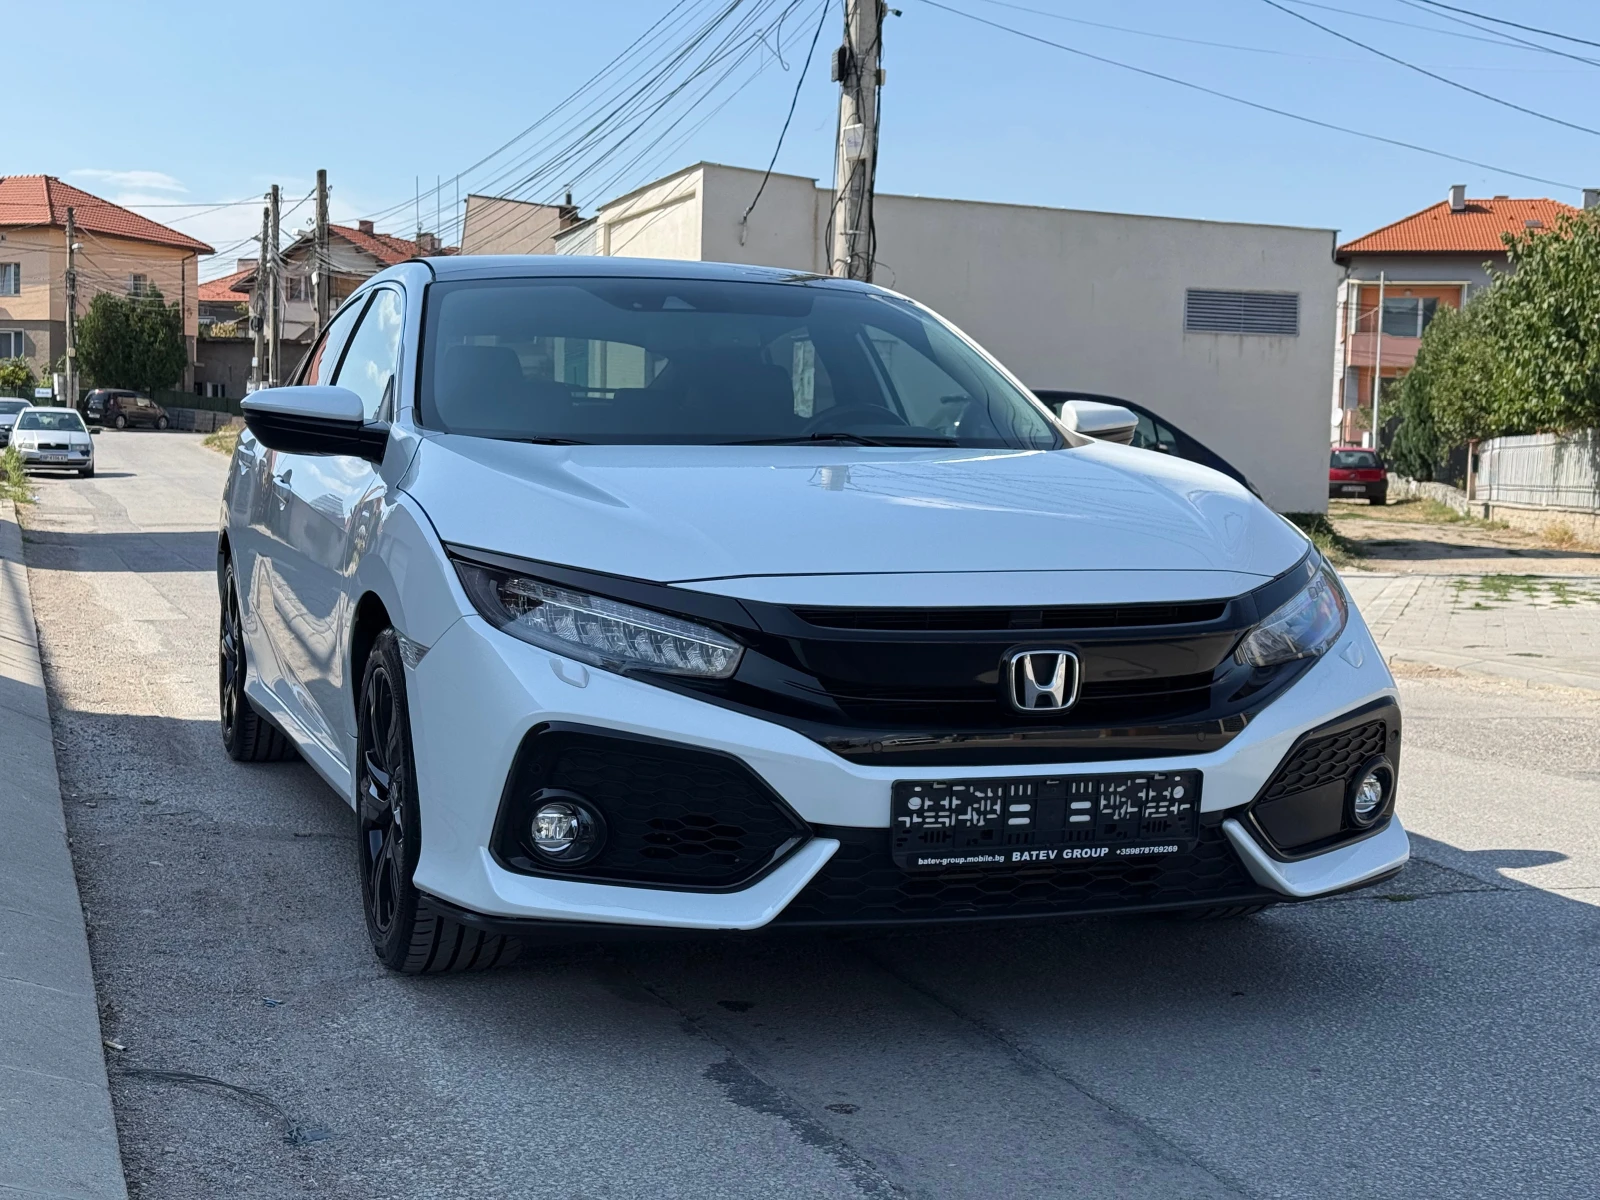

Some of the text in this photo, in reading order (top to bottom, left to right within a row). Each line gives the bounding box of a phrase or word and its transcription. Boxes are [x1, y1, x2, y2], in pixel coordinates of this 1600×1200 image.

[918, 845, 1178, 865] batev-group.mobile.bg BATEV GROUP +359878769269
